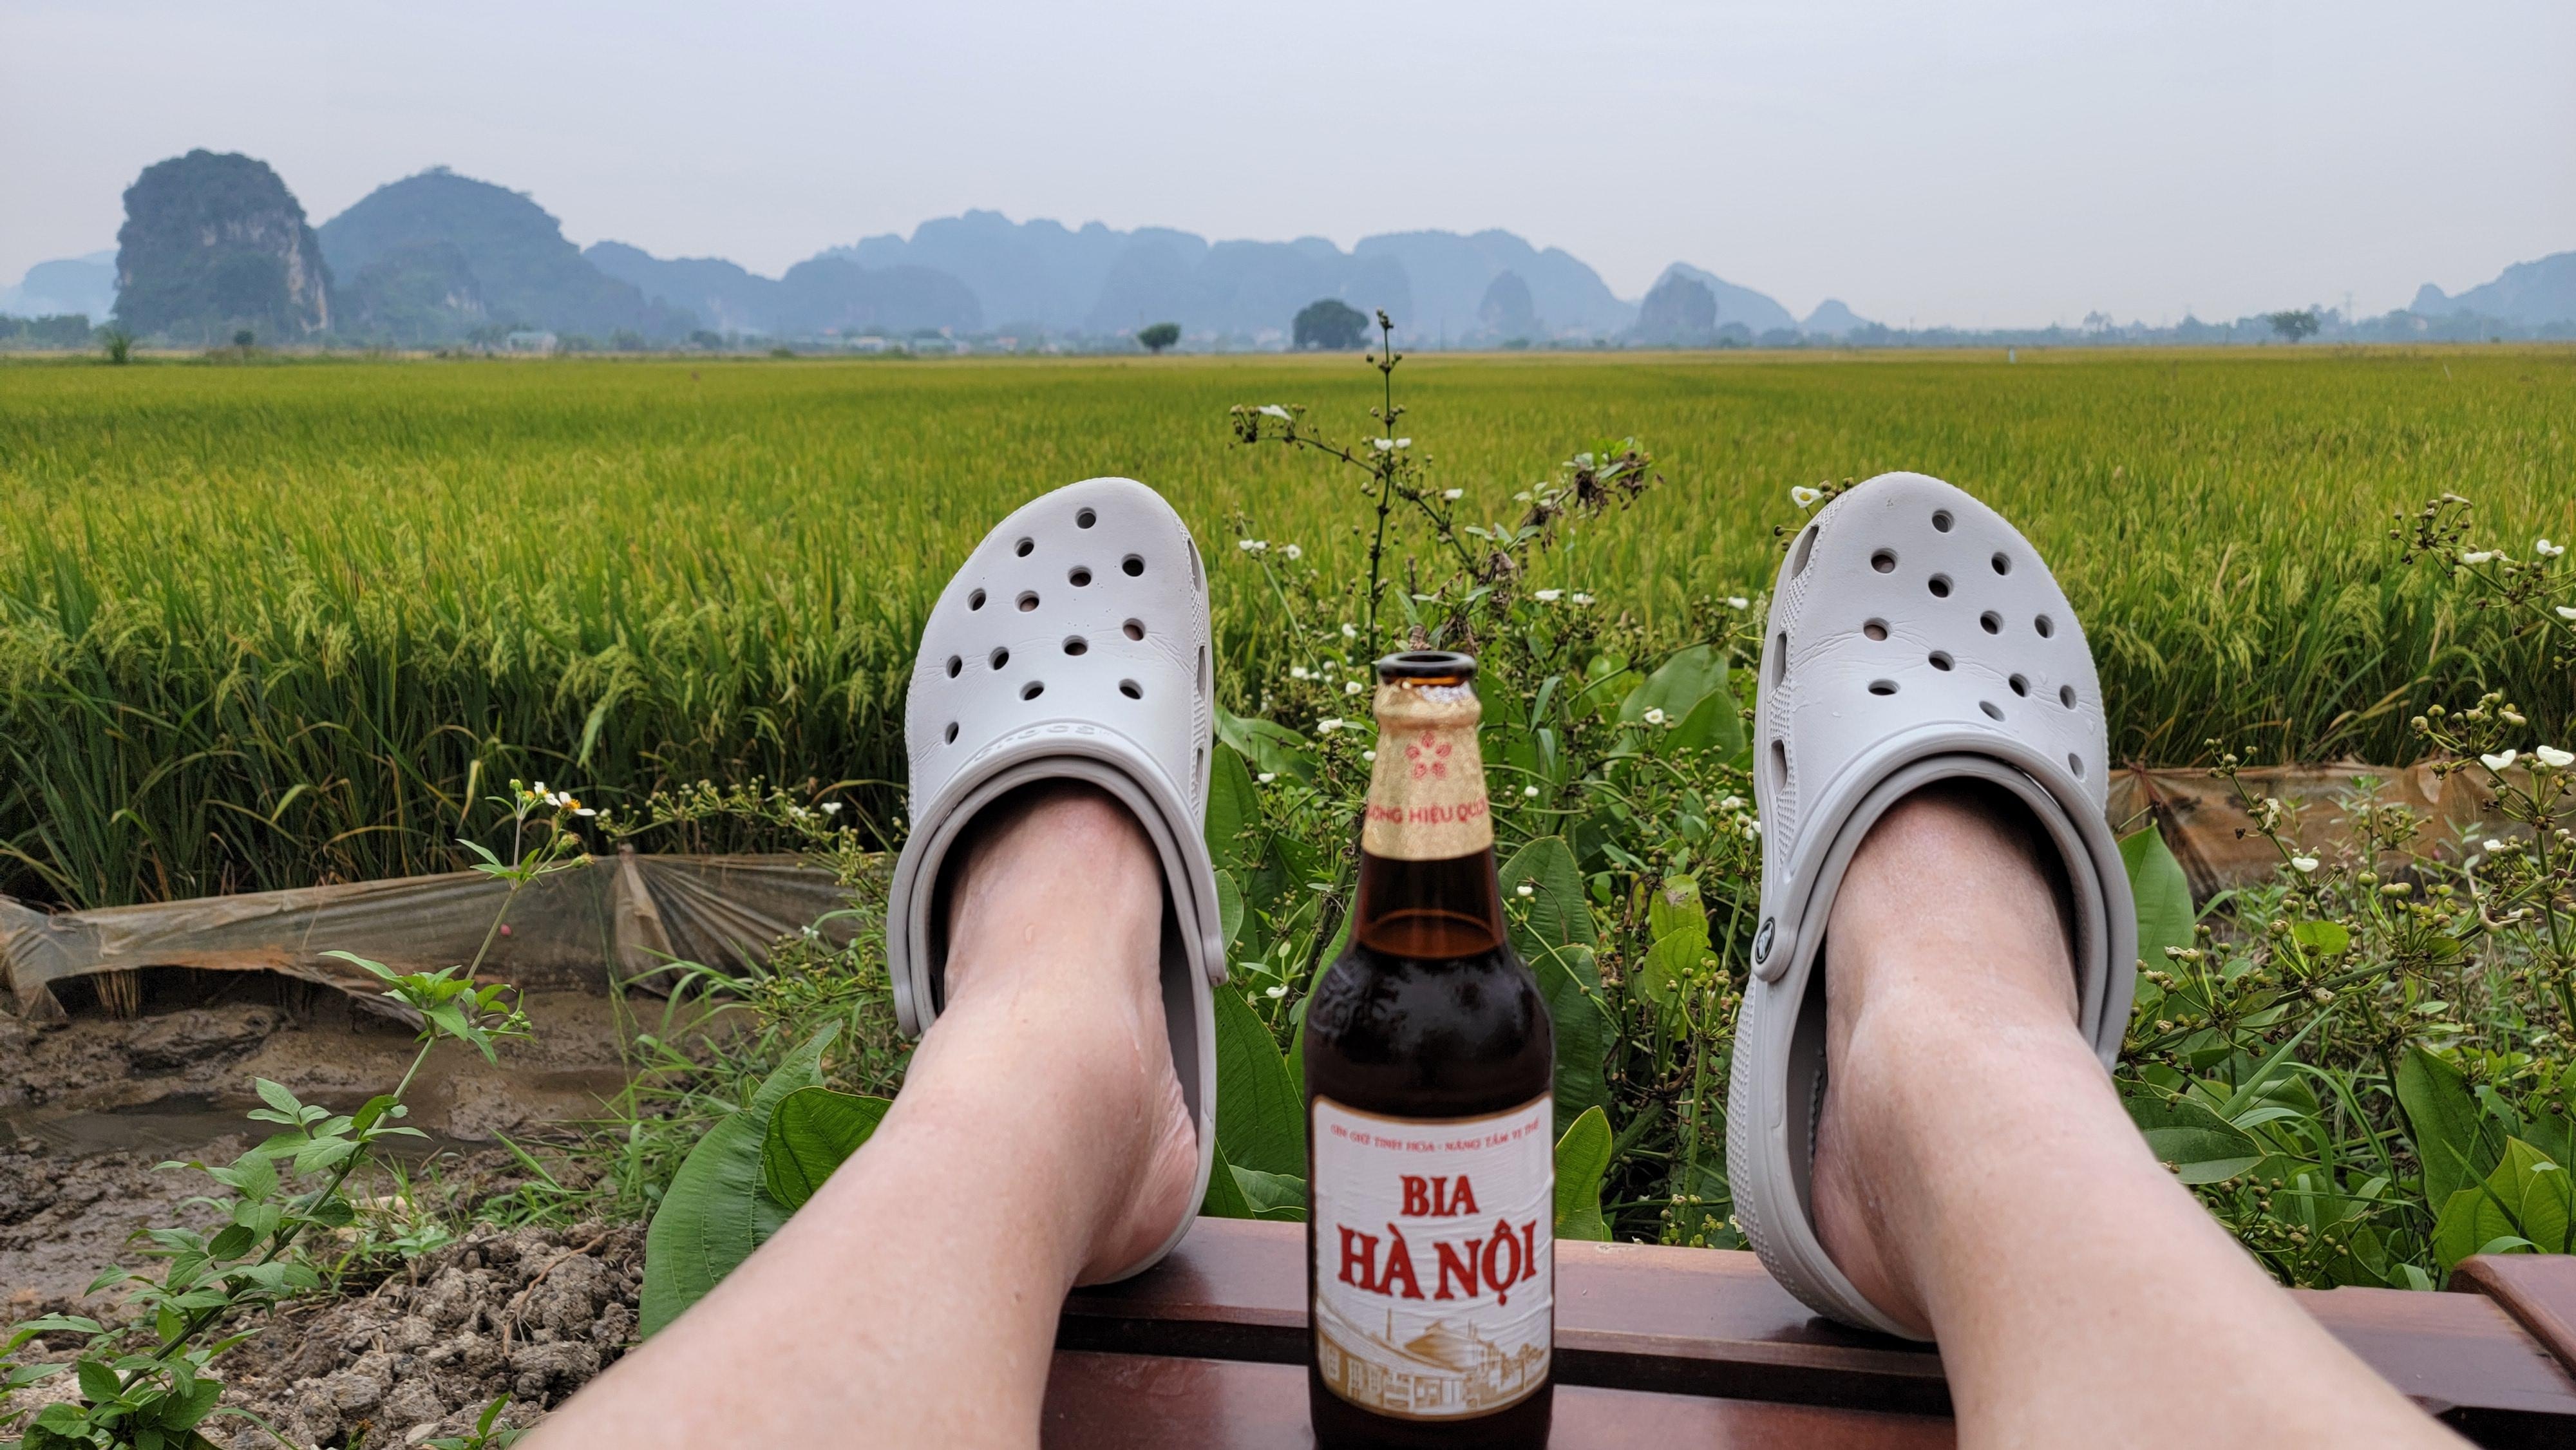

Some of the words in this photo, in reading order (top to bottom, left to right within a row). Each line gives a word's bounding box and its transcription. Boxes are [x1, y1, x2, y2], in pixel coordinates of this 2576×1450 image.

[1400, 1174, 1479, 1217] BIA
[1337, 1222, 1425, 1301] HÀ
[1434, 1219, 1537, 1306] NỘI
